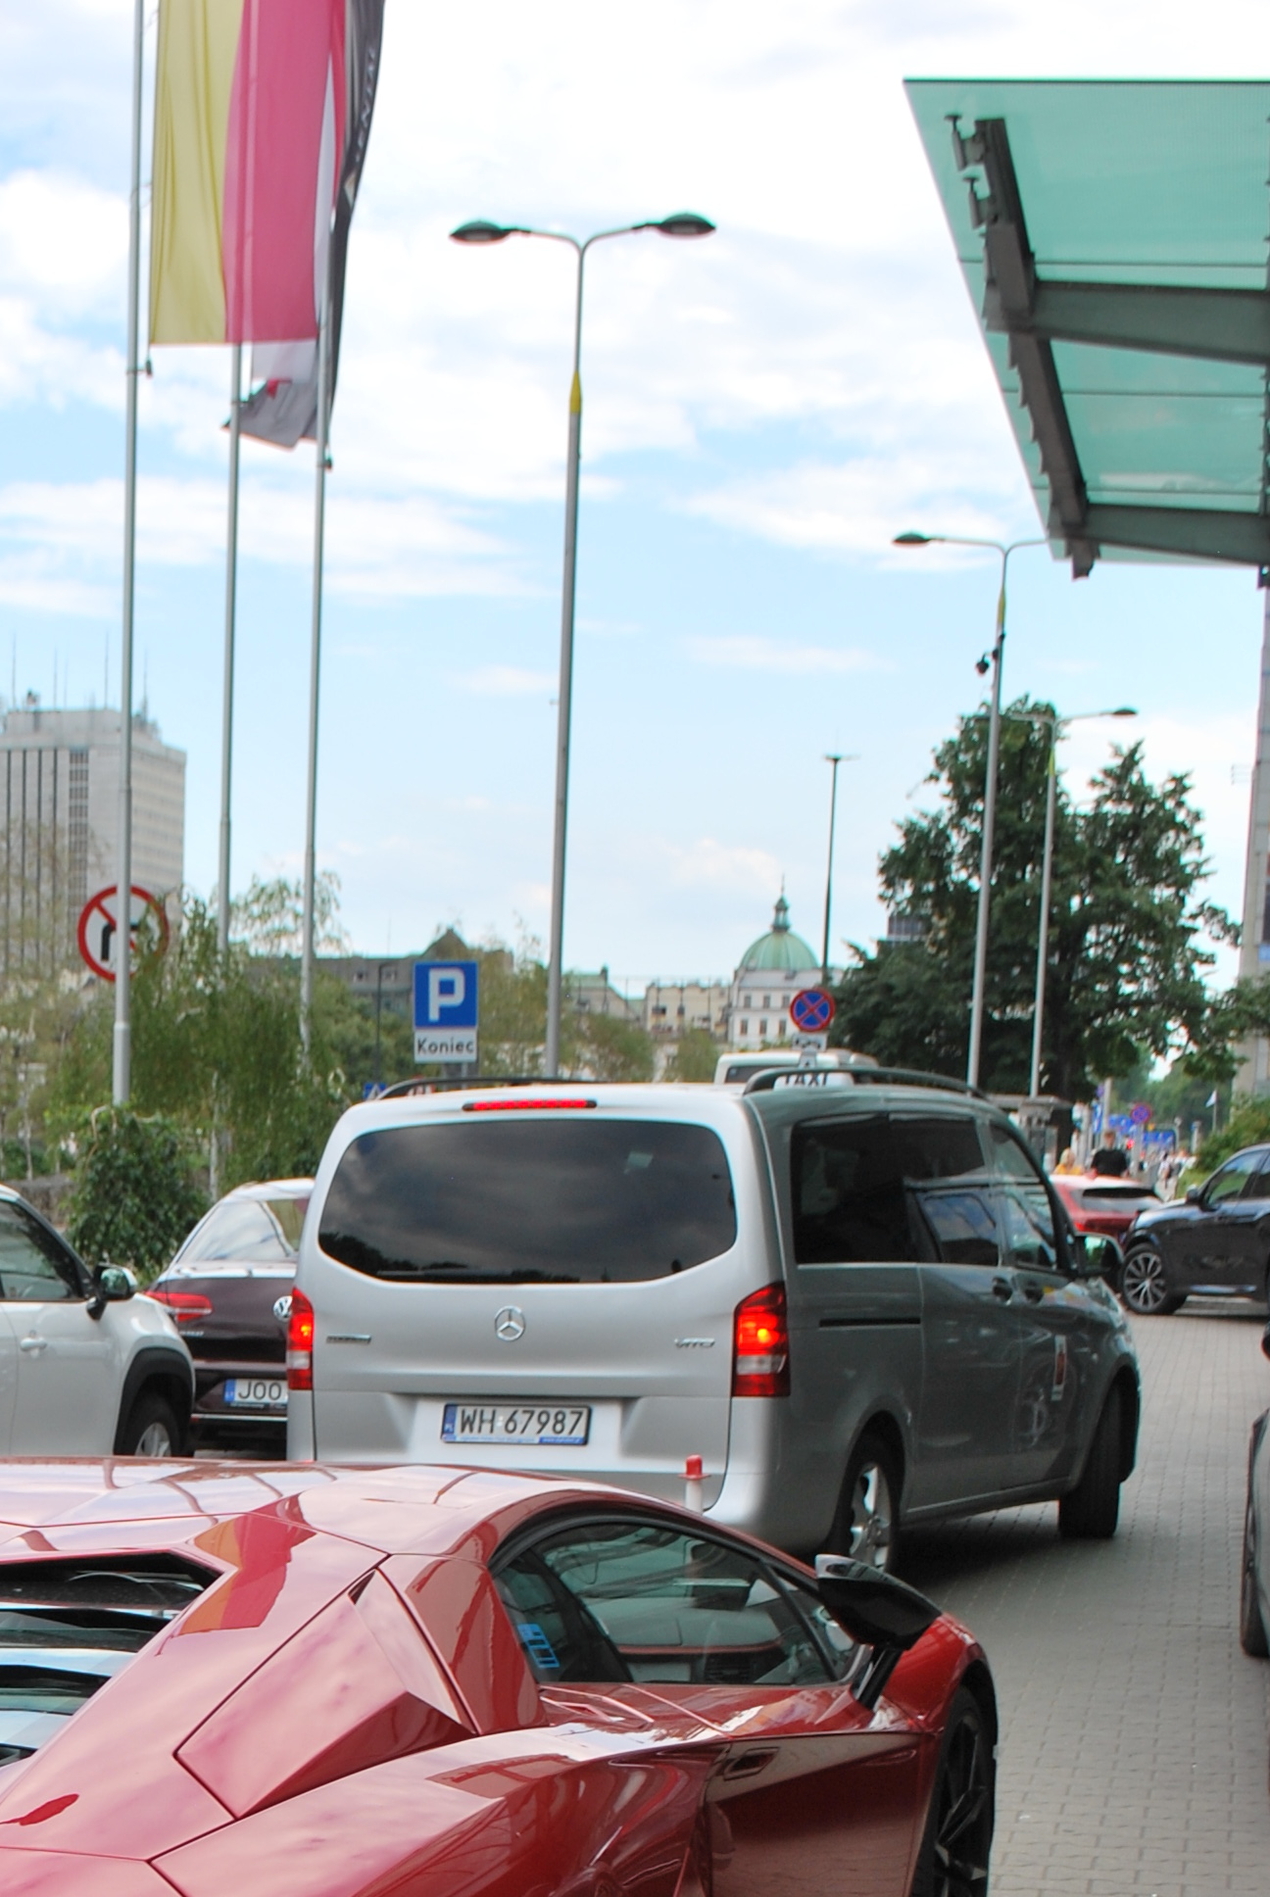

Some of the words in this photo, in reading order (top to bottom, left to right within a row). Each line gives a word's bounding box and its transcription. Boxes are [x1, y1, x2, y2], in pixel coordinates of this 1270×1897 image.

[428, 967, 465, 1022] P
[417, 1037, 475, 1055] Koniec
[460, 1409, 496, 1434] WH
[504, 1410, 584, 1435] 67987
